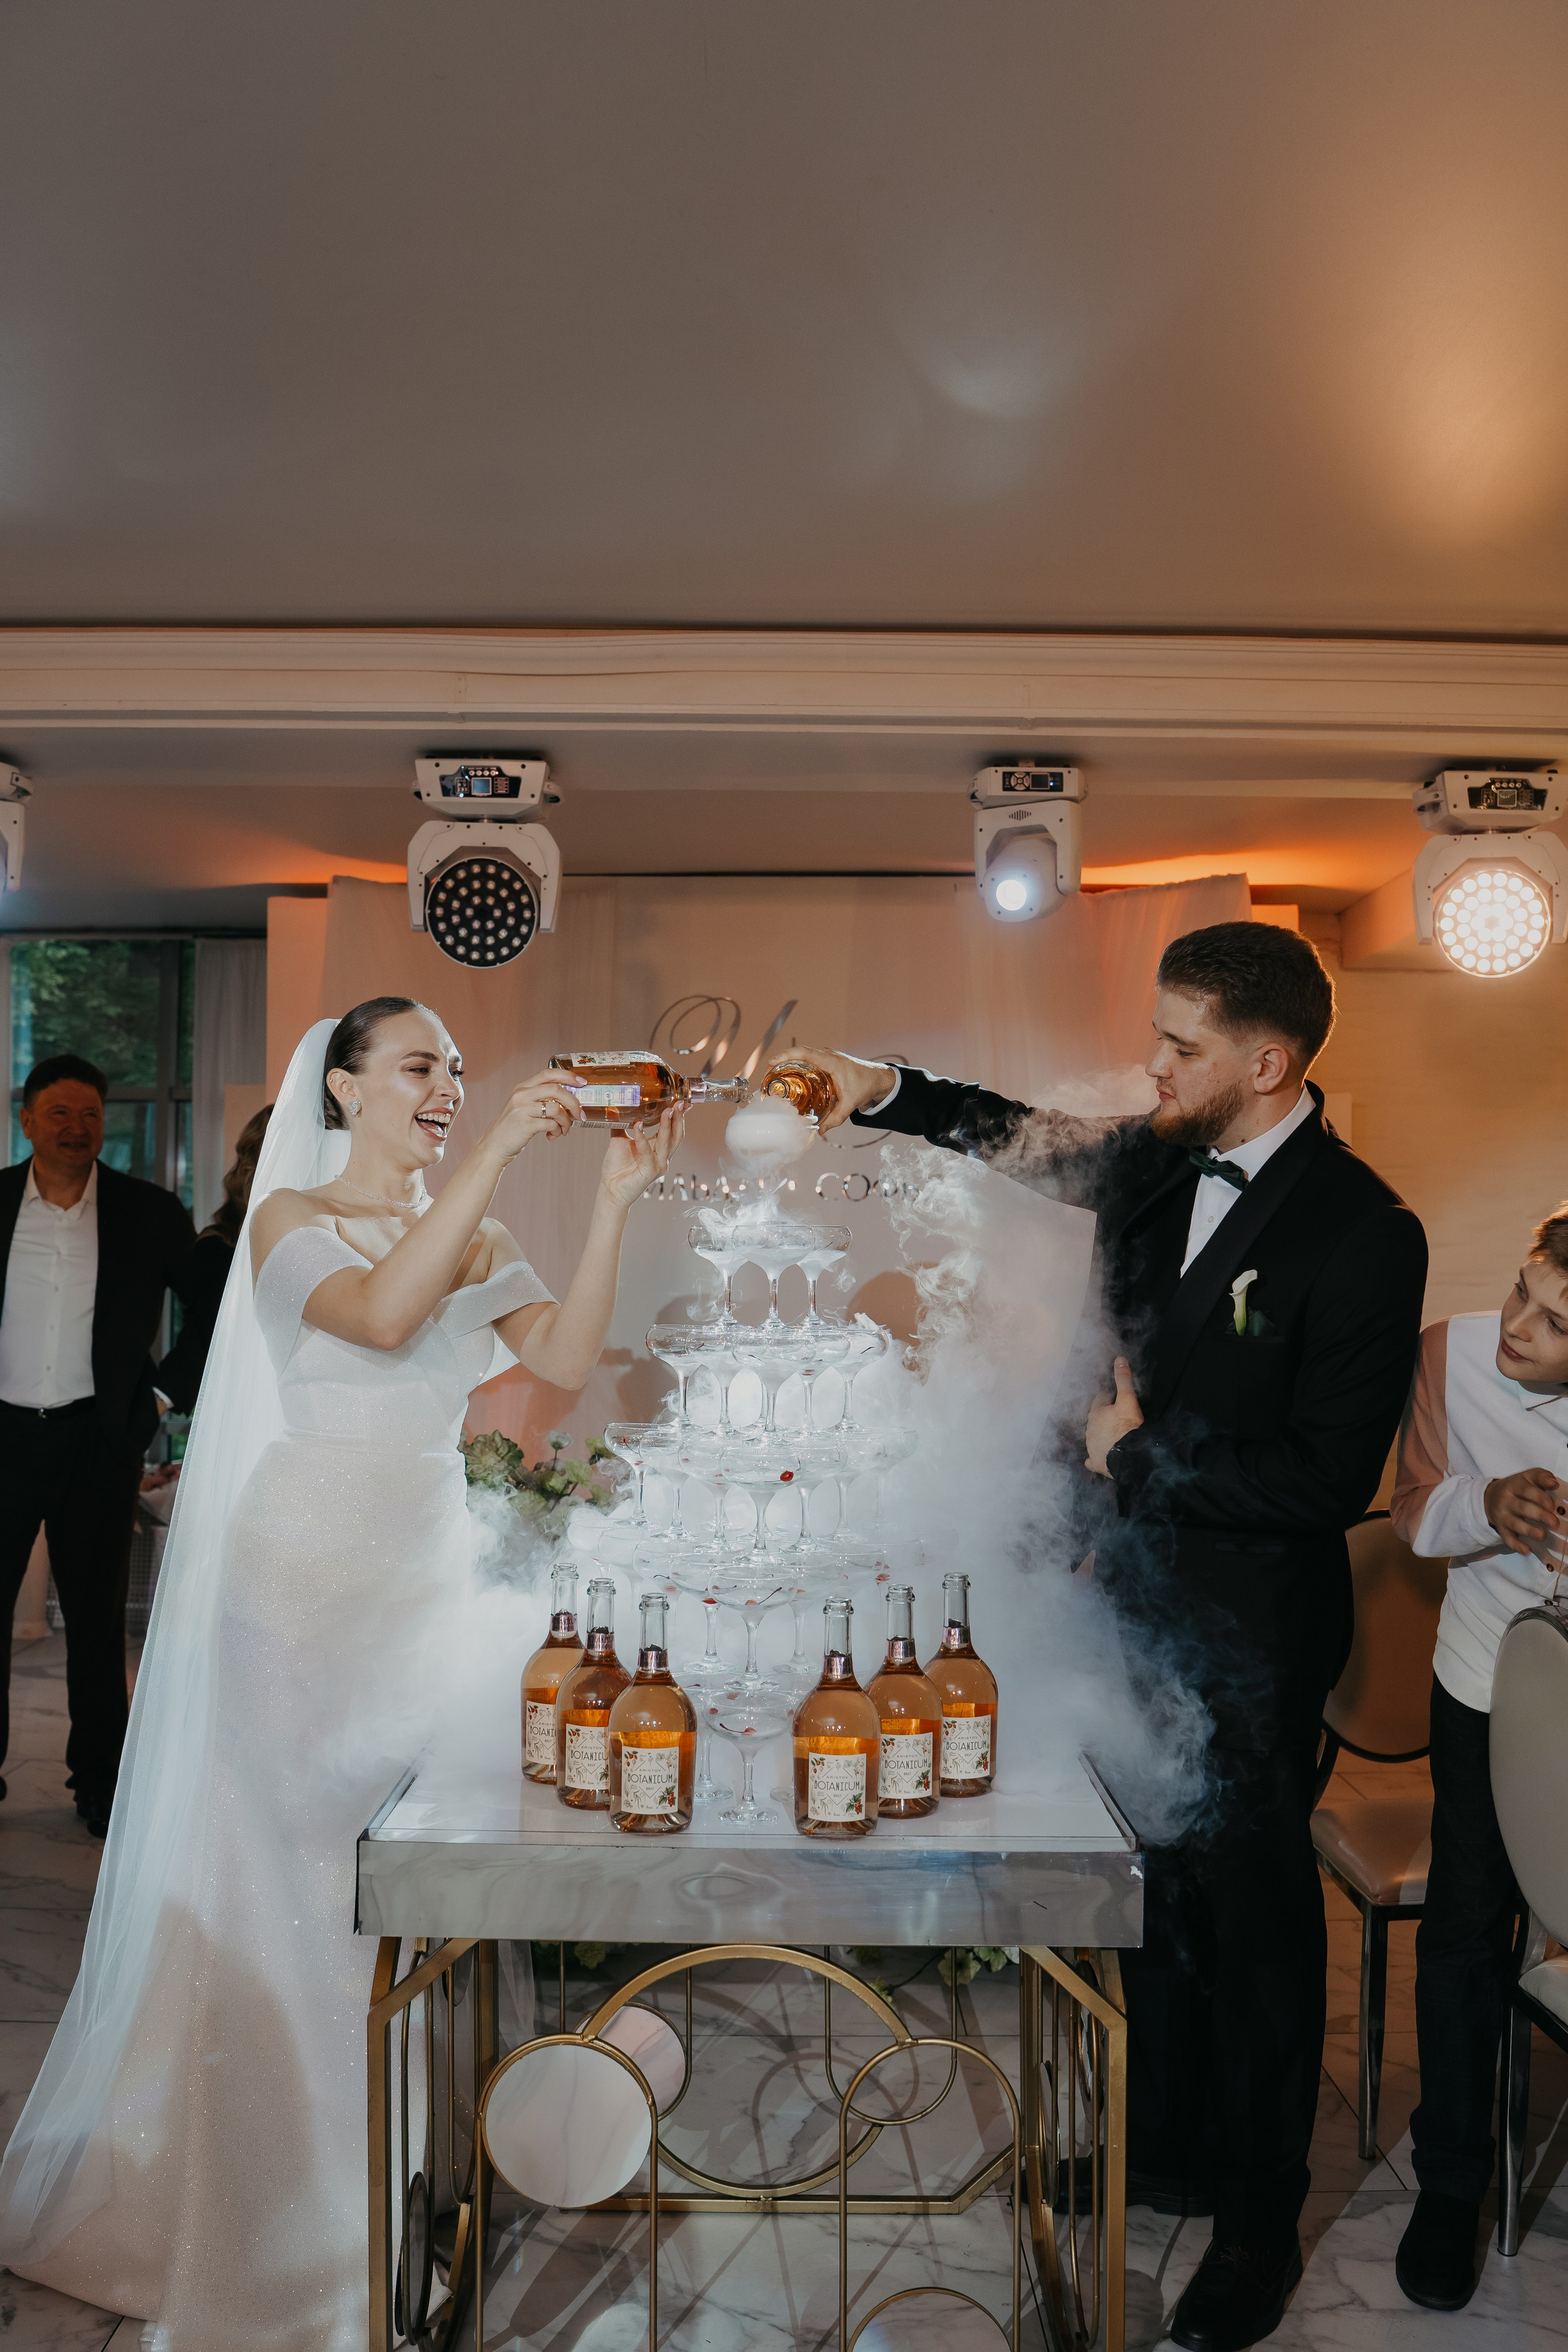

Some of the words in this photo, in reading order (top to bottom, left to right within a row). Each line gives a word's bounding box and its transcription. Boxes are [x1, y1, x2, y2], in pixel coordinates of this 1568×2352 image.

[530, 1725, 557, 1737] BOTANI
[946, 1740, 987, 1751] BOTANICUM
[570, 1749, 609, 1761] BOTANICU
[884, 1758, 928, 1770] BOTANICUM
[627, 1773, 673, 1784] BOTANICUM
[814, 1779, 860, 1791] BOTANICUM
